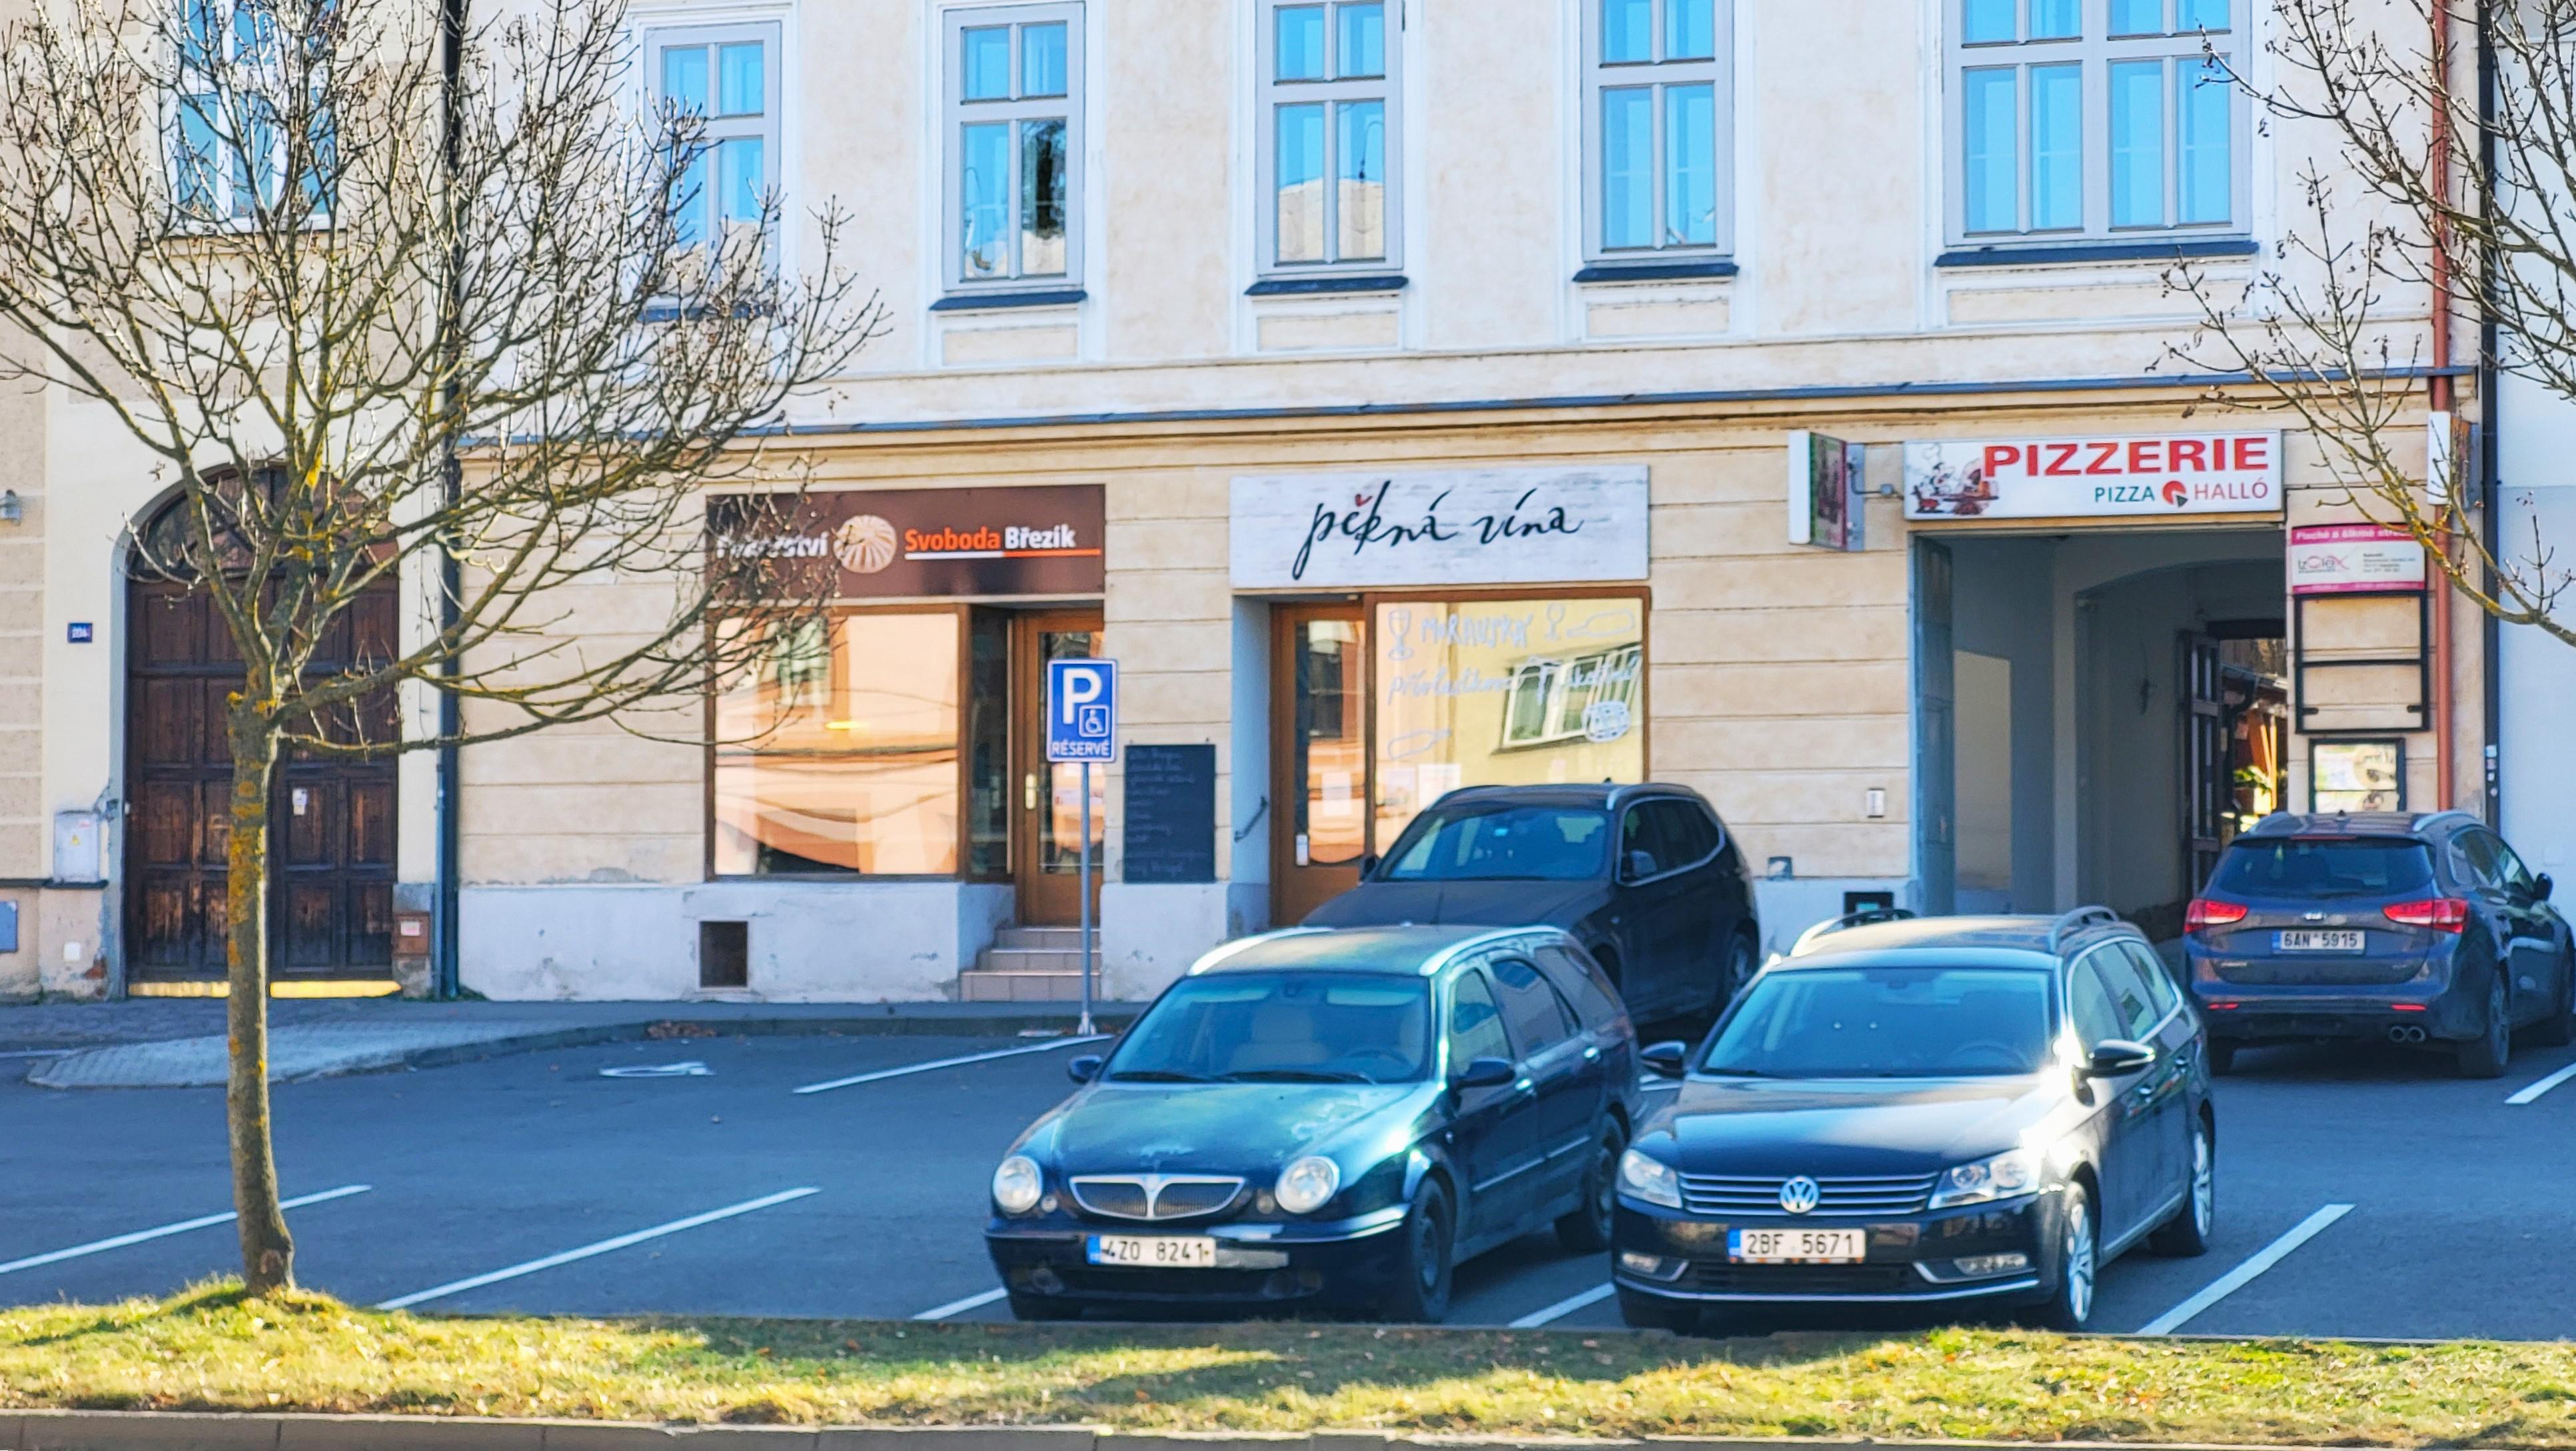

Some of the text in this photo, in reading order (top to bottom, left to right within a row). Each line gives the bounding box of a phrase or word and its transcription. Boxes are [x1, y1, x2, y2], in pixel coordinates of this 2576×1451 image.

[1983, 437, 2269, 478] PIZZERIE
[2094, 478, 2269, 503] PIZZA HALLÓ
[904, 523, 1075, 552] Svoboda Březík
[1292, 480, 1585, 580] pěkná vína
[1063, 668, 1102, 725] P
[1051, 738, 1110, 756] RÉSERVÉ
[2284, 933, 2357, 946] 6AN 5915
[1156, 1242, 1203, 1262] 8241
[1747, 1234, 1852, 1254] 2BF 5671
